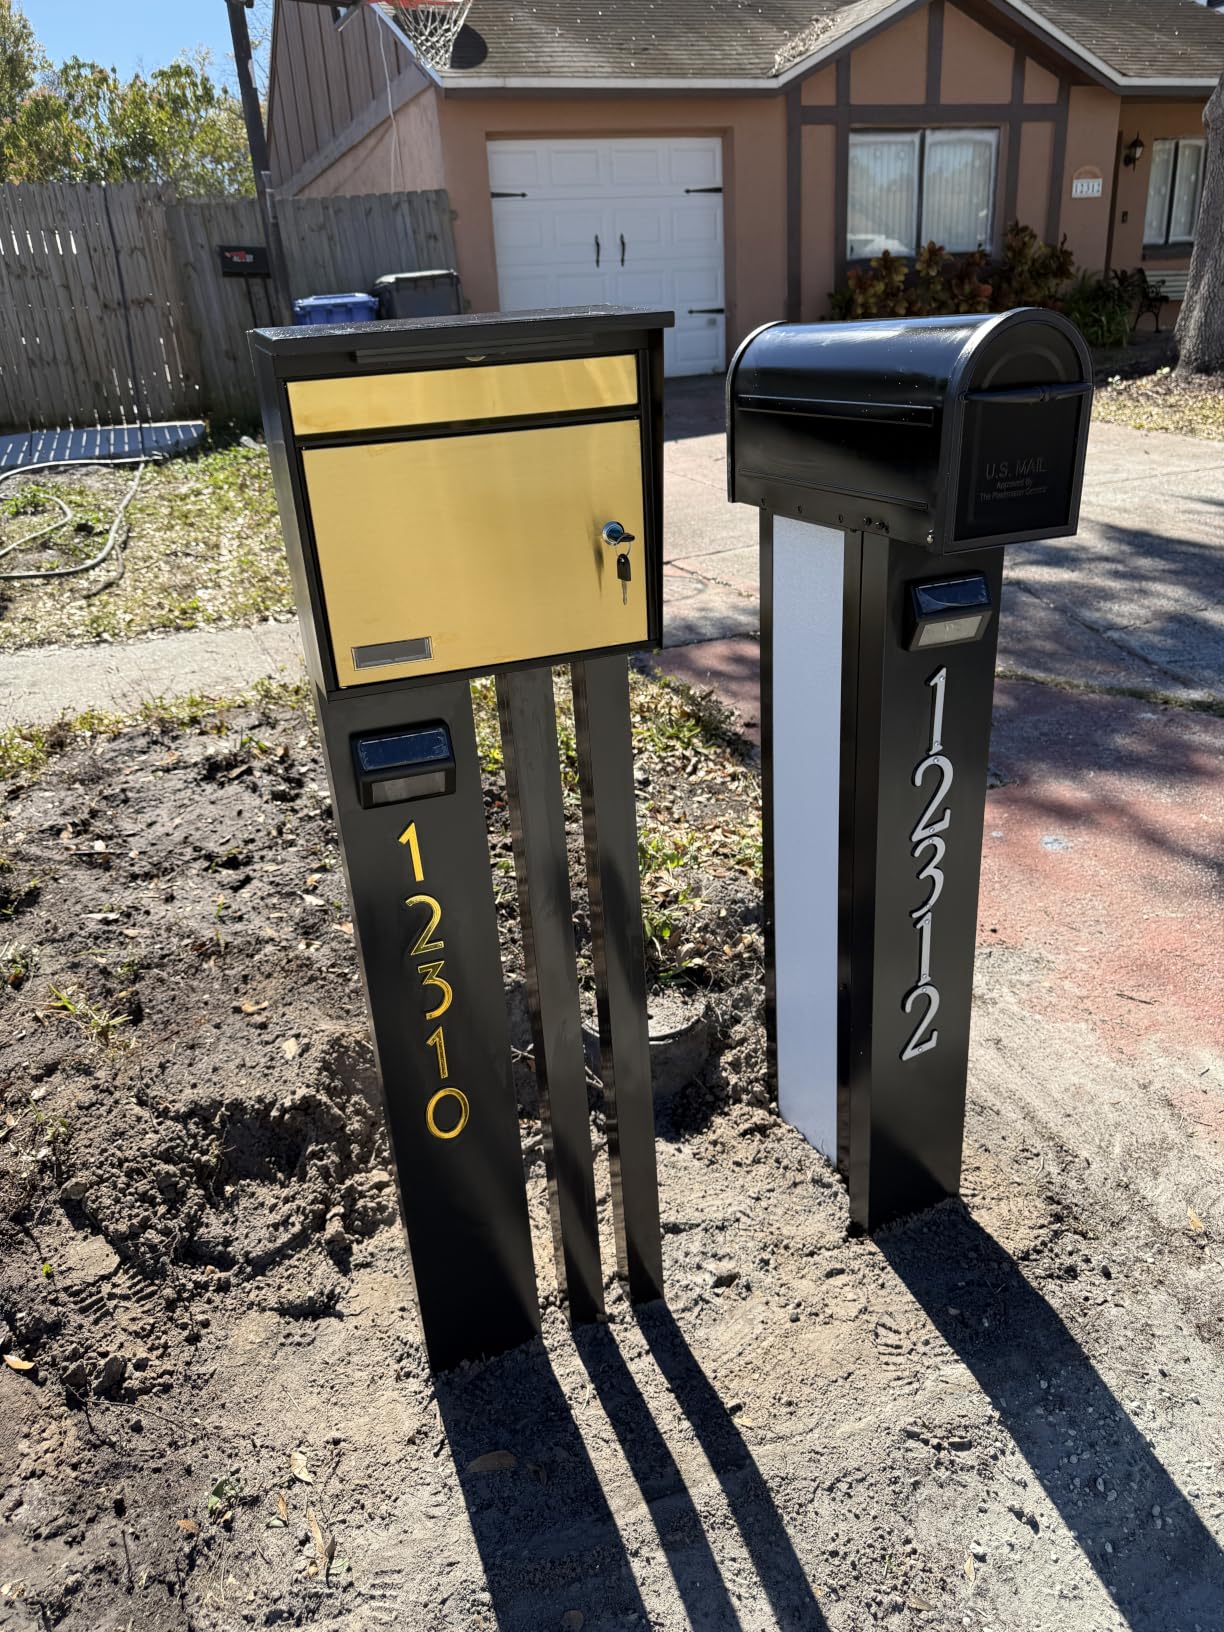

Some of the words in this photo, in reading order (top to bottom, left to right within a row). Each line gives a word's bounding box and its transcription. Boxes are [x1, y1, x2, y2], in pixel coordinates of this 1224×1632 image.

[985, 461, 1011, 480] U.S.
[1016, 456, 1049, 477] MAIL
[398, 821, 470, 1140] 12310
[899, 665, 954, 1061] 12312
